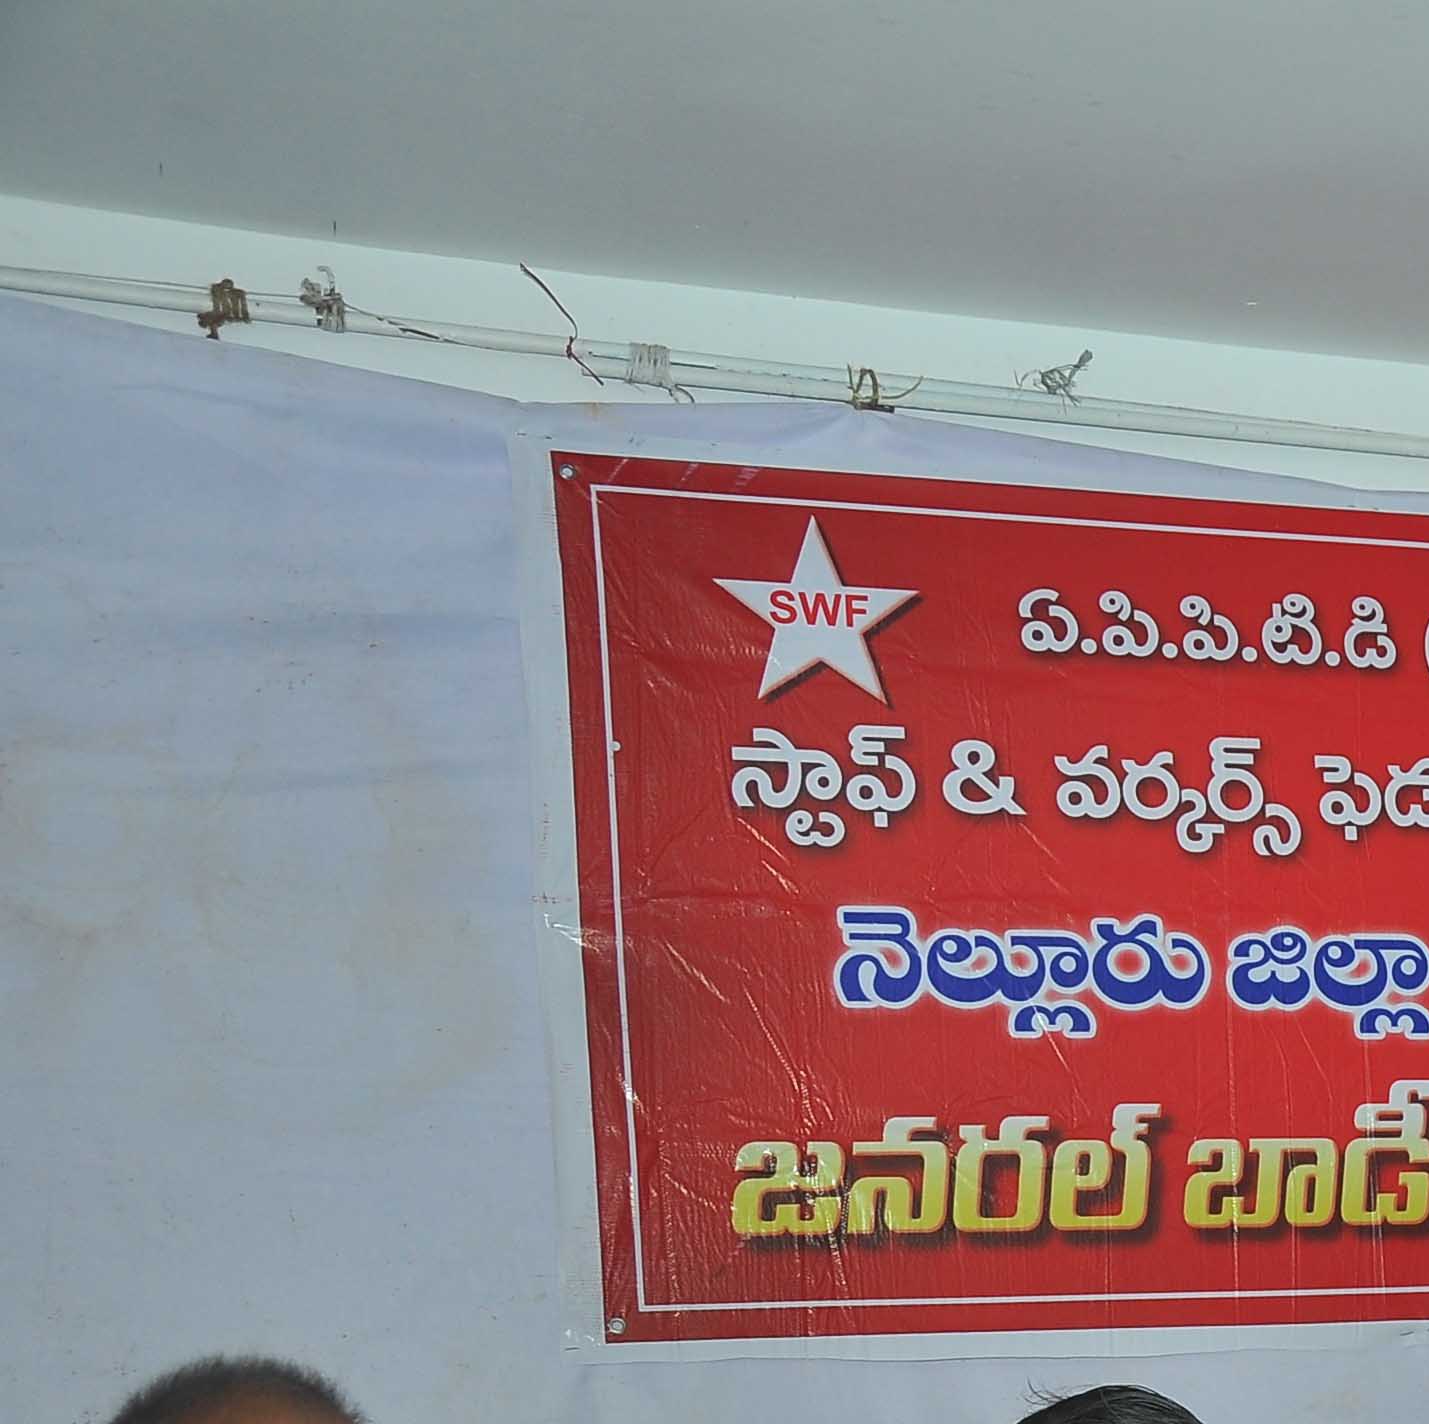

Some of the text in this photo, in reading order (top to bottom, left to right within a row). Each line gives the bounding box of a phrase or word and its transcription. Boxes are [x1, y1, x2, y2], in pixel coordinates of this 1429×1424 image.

[768, 588, 870, 627] SWF
[731, 725, 917, 848] స్టాఫ్
[942, 739, 1026, 815] &
[1055, 737, 1303, 857] వర్కర్స్
[832, 905, 1212, 1039] నెల్లూరు
[730, 1102, 1163, 1236] జనరల్
